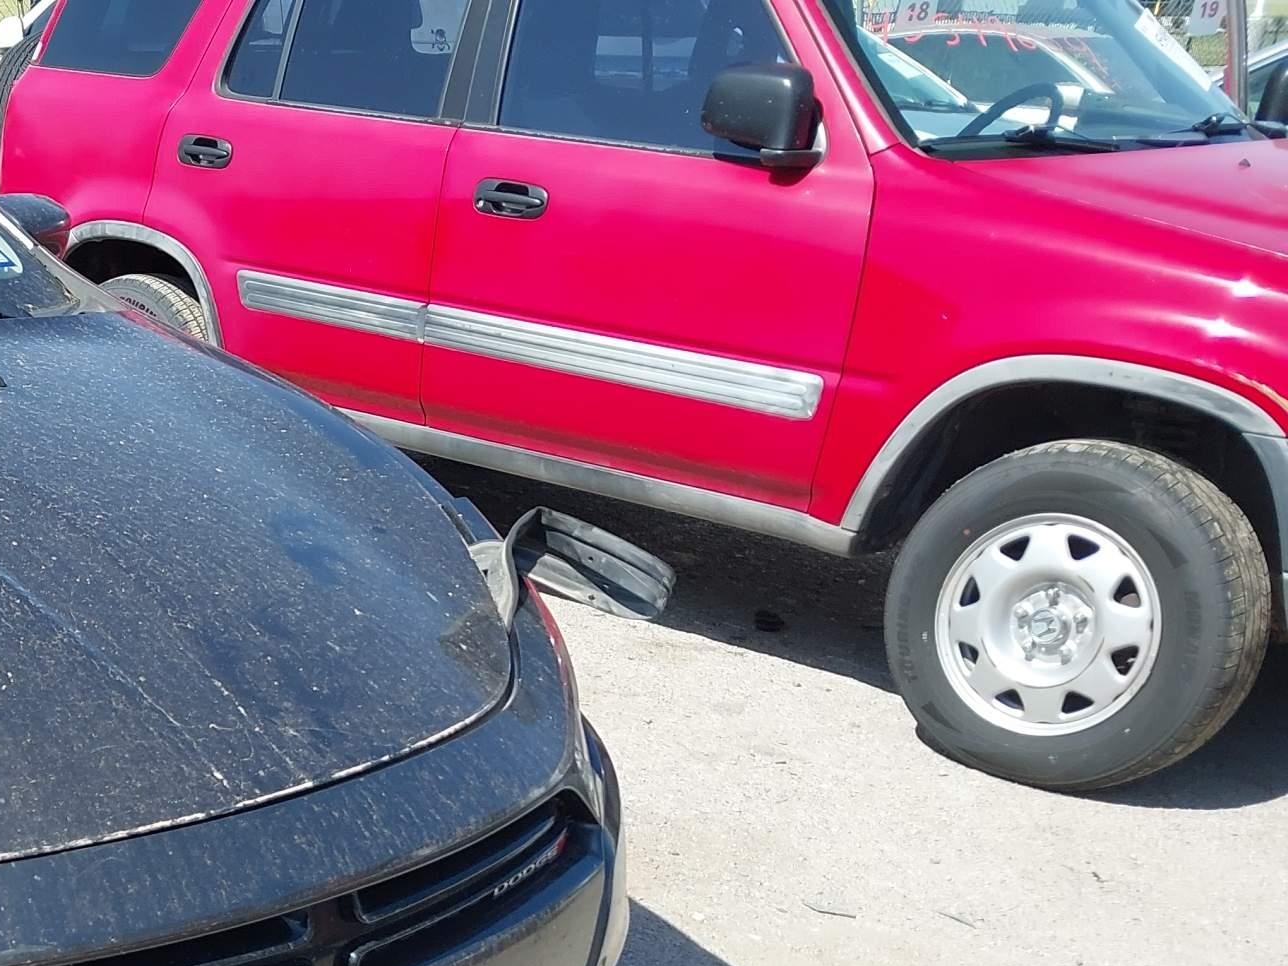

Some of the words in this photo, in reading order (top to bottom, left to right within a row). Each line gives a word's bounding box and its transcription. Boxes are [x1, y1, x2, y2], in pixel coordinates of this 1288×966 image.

[907, 1, 930, 21] 18
[1200, 1, 1220, 19] 19
[493, 846, 559, 898] DODGE
